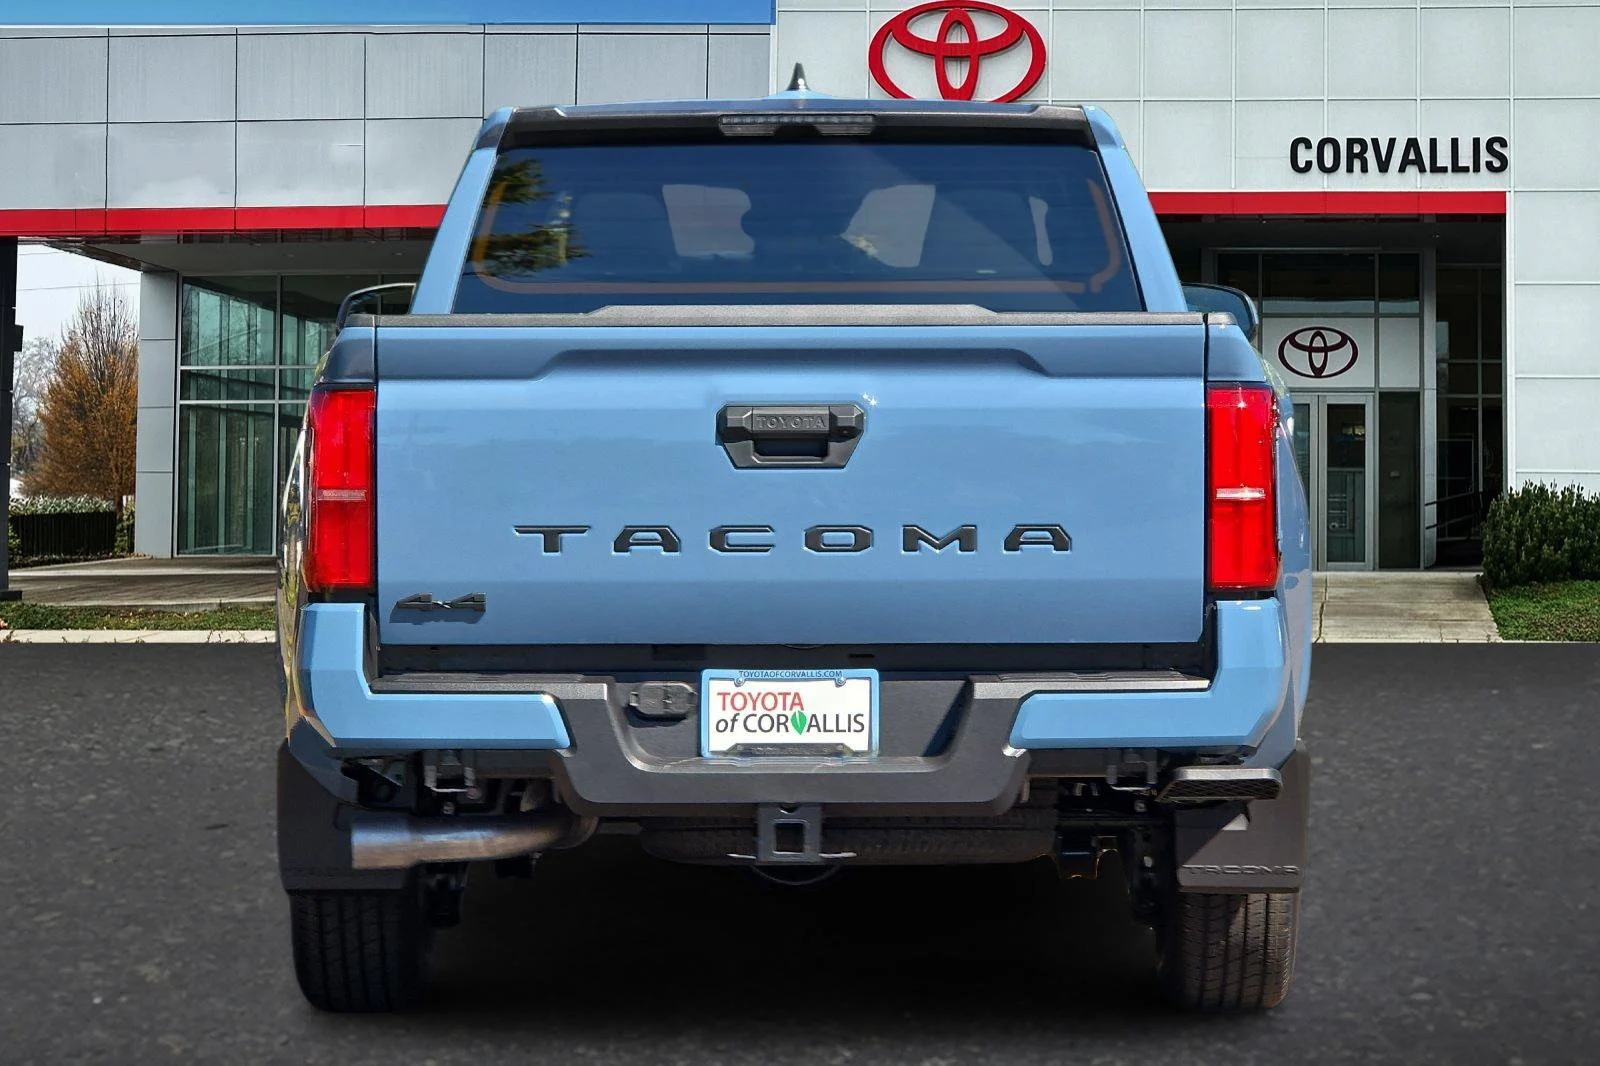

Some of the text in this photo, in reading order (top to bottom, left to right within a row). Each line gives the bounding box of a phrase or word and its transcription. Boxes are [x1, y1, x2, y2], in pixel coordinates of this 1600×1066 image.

[1290, 136, 1509, 173] CORVALLIS
[755, 416, 826, 429] TOYOTA
[513, 525, 1073, 553] TACOMA
[739, 670, 842, 678] TOYOTAOFCORVALLIS.COM
[717, 692, 804, 711] TOYOTA
[716, 713, 739, 733] of
